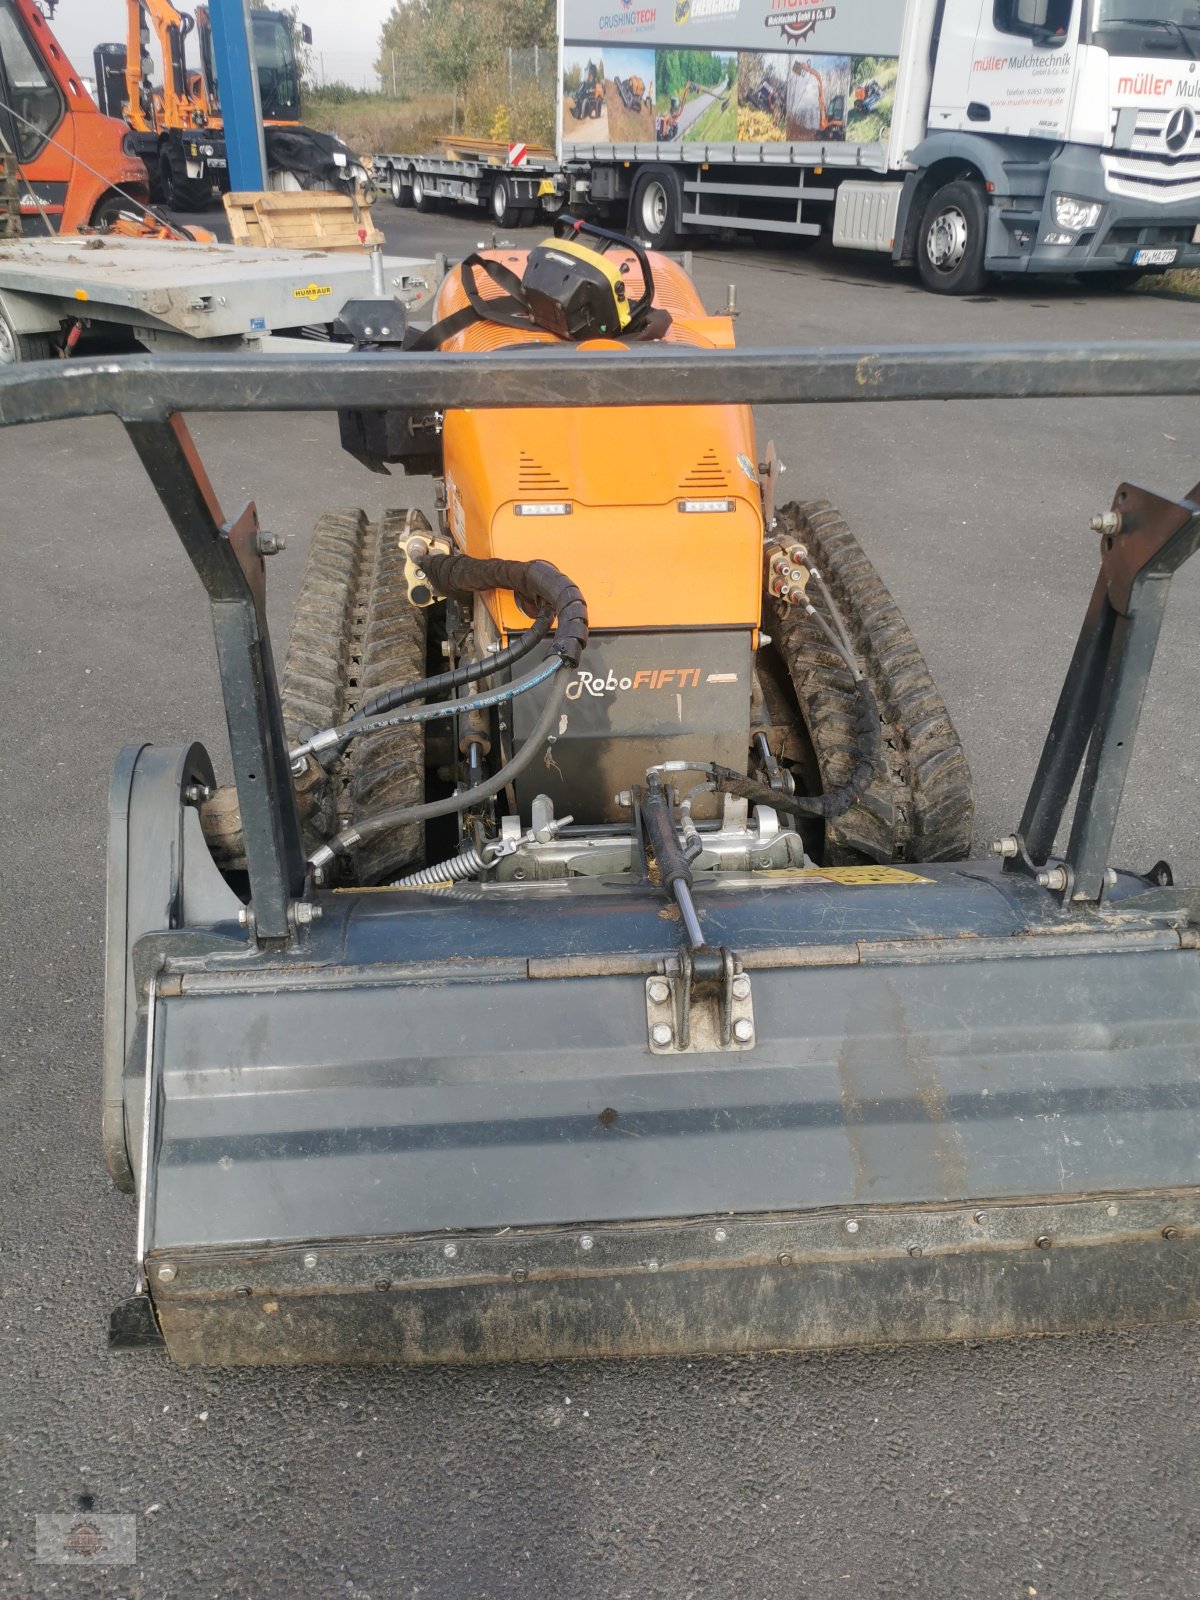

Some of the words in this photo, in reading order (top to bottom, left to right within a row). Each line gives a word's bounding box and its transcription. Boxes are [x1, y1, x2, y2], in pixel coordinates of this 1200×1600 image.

[1008, 53, 1071, 69] Mulchtechnik
[1117, 73, 1173, 96] müller
[1175, 79, 1200, 97] Mul
[295, 287, 331, 296] HUMBAUR
